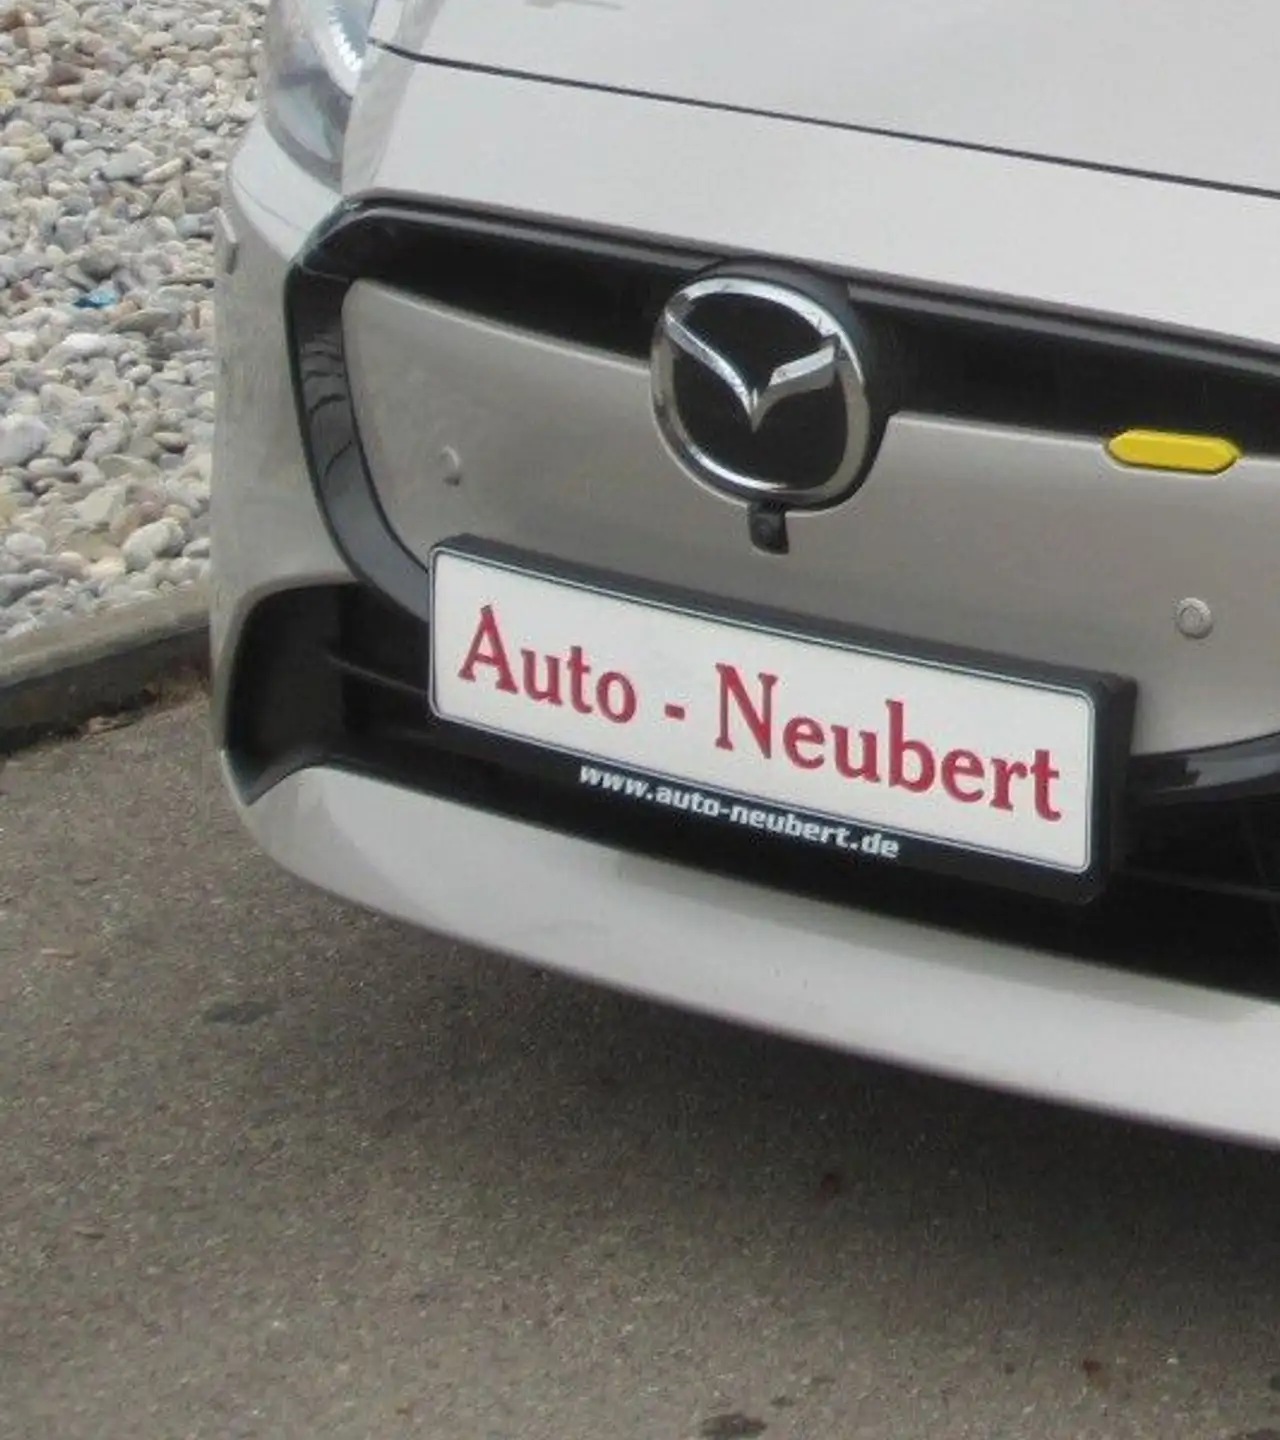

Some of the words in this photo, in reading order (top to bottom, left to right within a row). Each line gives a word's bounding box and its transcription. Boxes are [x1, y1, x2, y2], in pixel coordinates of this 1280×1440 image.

[457, 604, 637, 725] Auto
[664, 703, 686, 721] -
[714, 661, 1062, 823] Neubert
[578, 763, 900, 859] www.auto-neubert.de
